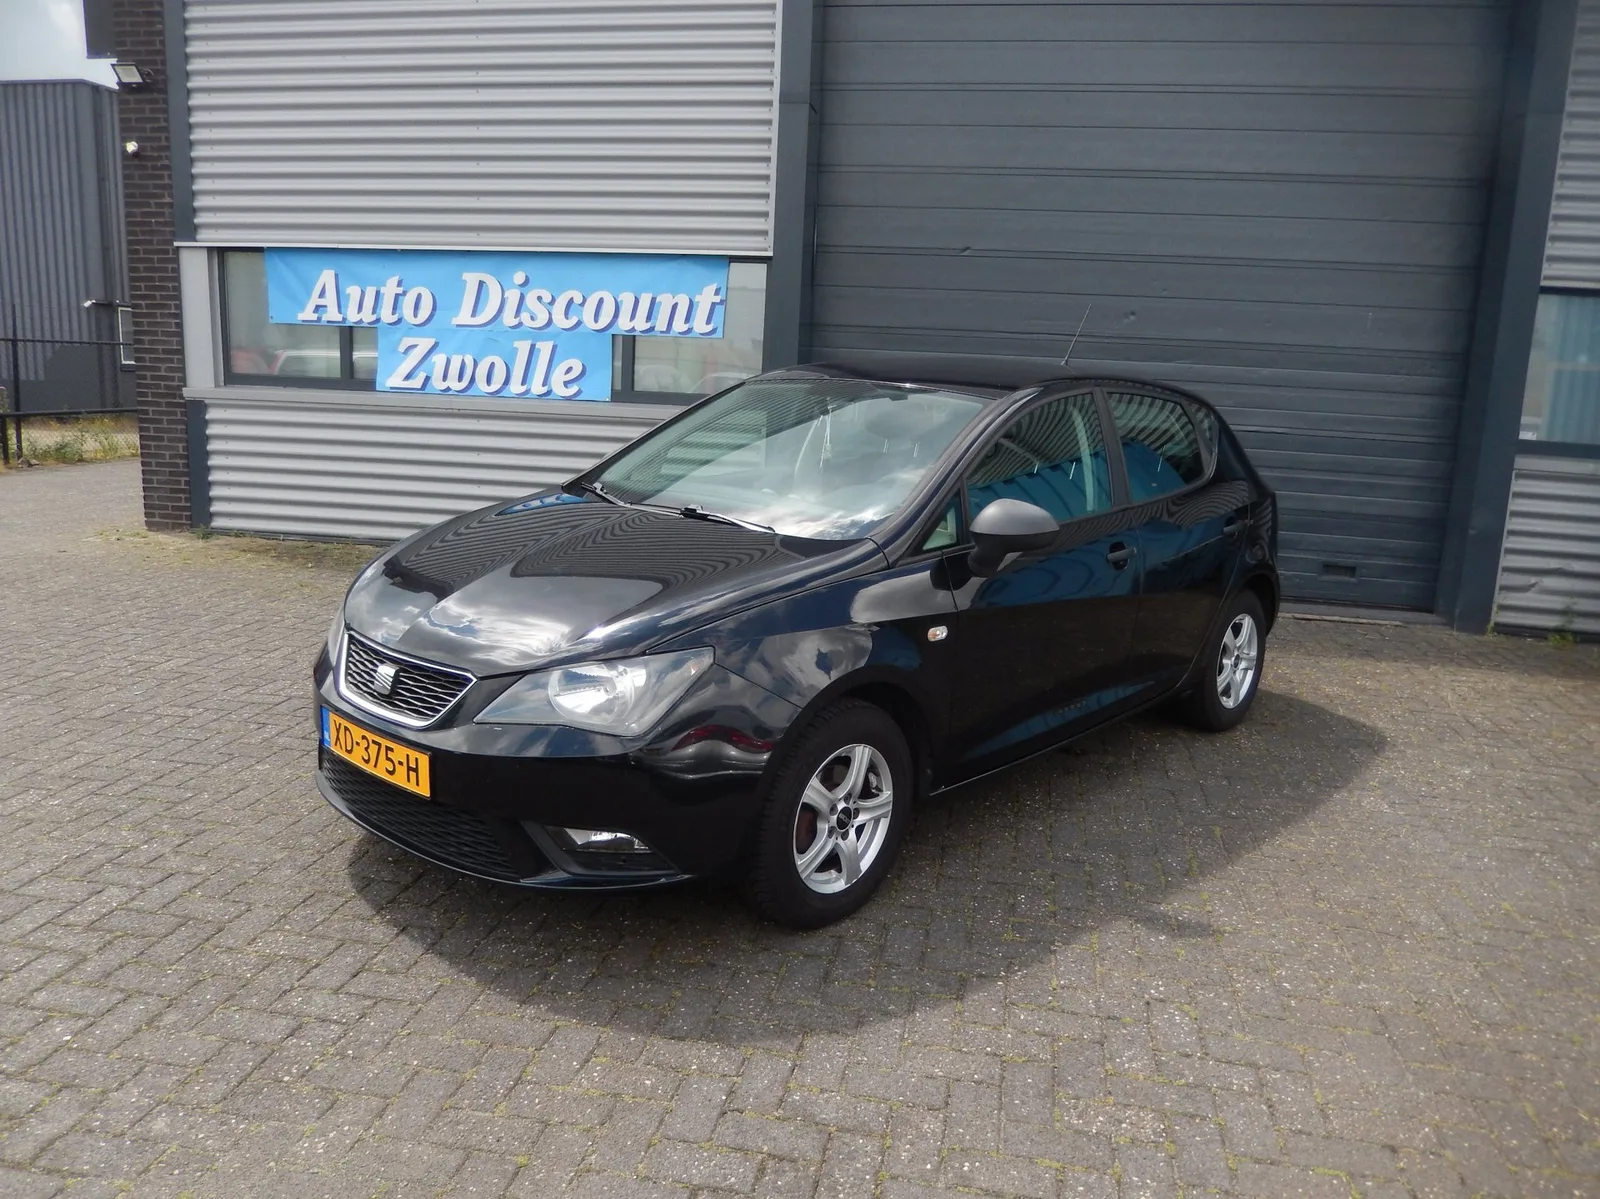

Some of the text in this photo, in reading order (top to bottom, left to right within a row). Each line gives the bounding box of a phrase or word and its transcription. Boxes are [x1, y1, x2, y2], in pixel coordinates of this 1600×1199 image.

[297, 269, 721, 336] Auto Discount
[386, 336, 585, 397] Zwolle
[332, 719, 420, 787] XD-375-H
